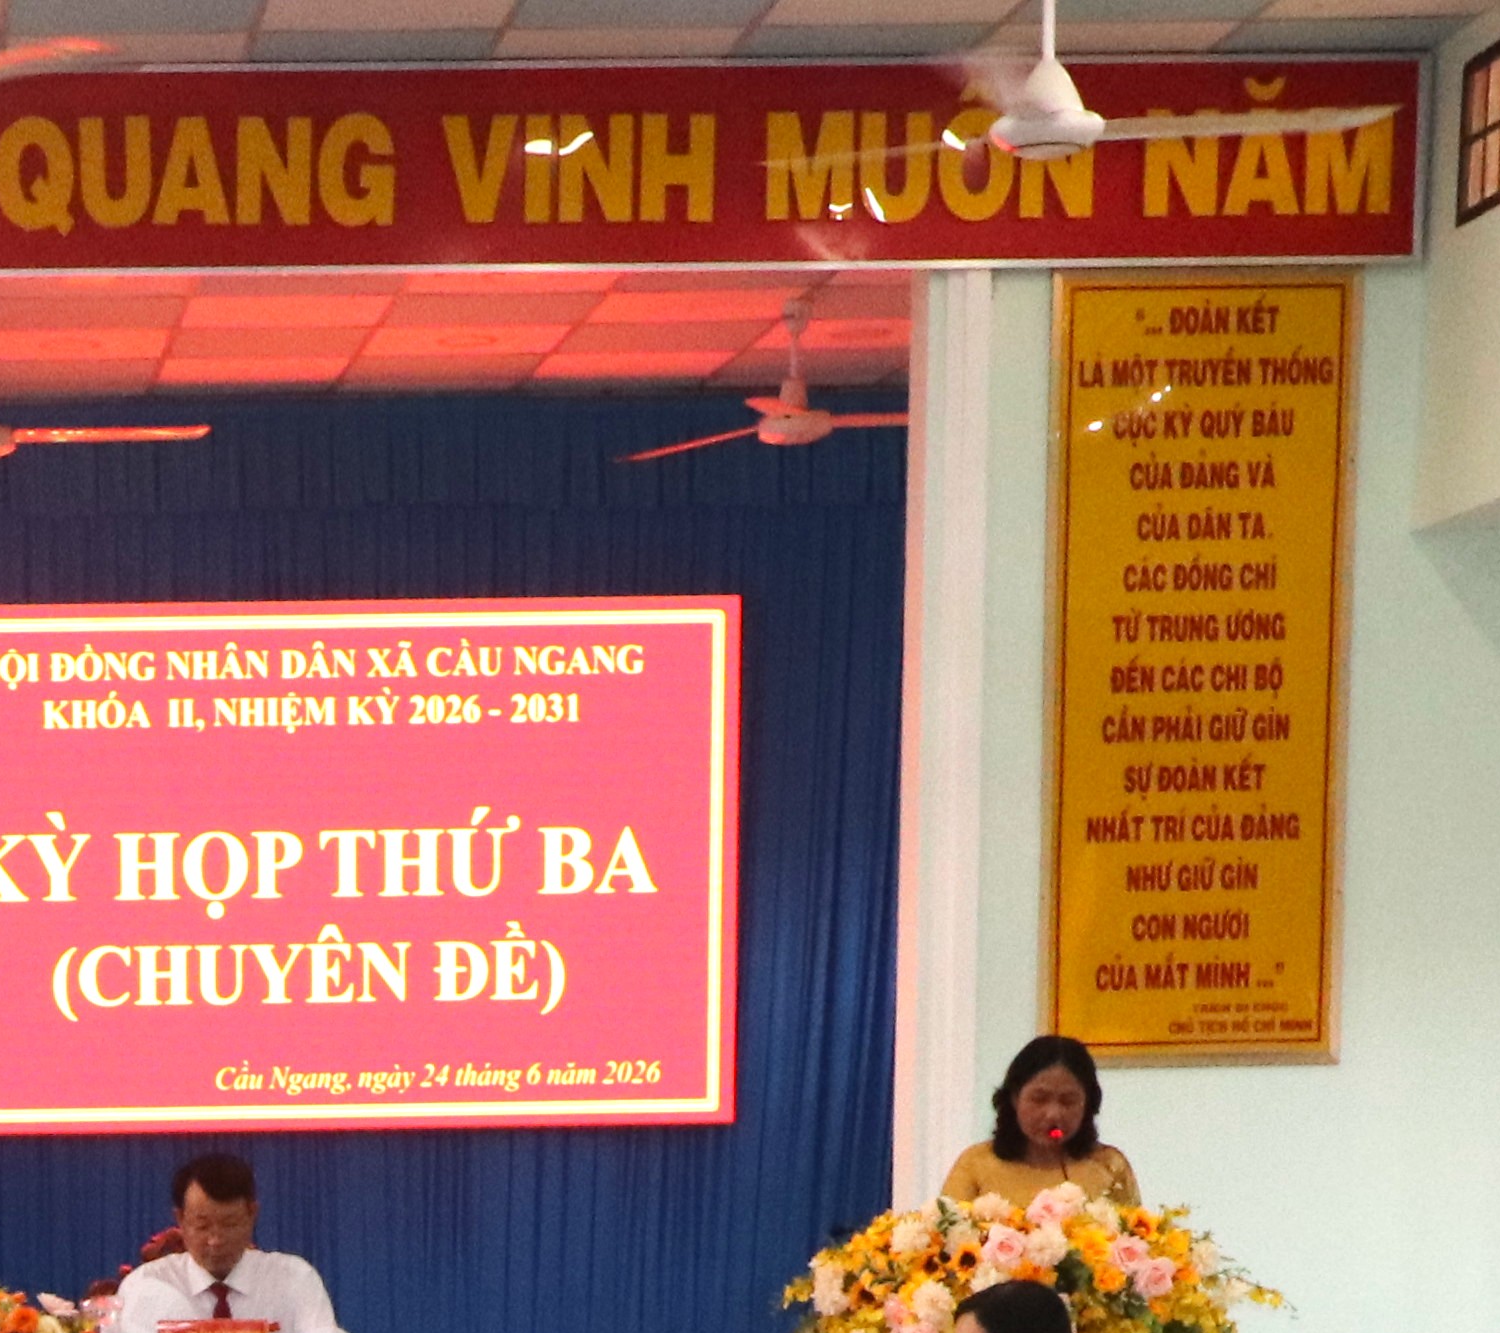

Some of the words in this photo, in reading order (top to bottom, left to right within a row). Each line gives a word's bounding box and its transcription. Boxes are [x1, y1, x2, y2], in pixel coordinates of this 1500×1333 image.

[442, 112, 715, 225] VINH
[767, 82, 1096, 223] MUÔN
[1141, 76, 1394, 217] NĂM
[1169, 298, 1230, 335] ĐOÀN
[1236, 293, 1280, 333] KẾT
[1129, 450, 1173, 490] CỦA
[1178, 448, 1240, 490] ĐẢNG
[1246, 454, 1275, 488] VÀ
[1137, 503, 1181, 540] CỦA
[1187, 506, 1231, 540] DÂN
[1123, 557, 1167, 592] CÁC
[1172, 553, 1234, 590] ĐỒNG
[1240, 555, 1278, 590] CHÍ
[1112, 608, 1141, 642] TỪ
[1147, 614, 1219, 641] TRUNG
[1226, 608, 1286, 641] ƯƠNG
[50, 644, 155, 682] ĐỒNG
[167, 642, 268, 680] NHÂN
[281, 641, 355, 679] DÂN
[367, 641, 417, 677] XÃ
[426, 639, 502, 677] CẦU
[514, 644, 644, 675] NGANG
[1110, 656, 1154, 693] ĐẾN
[1161, 658, 1205, 692] CÁC
[1210, 664, 1247, 692] CHI
[1254, 657, 1284, 700] BỘ
[43, 691, 150, 729] KHÓA
[169, 698, 205, 731] II,
[214, 692, 336, 733] NHIỆM
[348, 687, 399, 725] KỲ
[409, 694, 481, 724] 2026
[510, 693, 579, 723] 2031
[1123, 762, 1153, 801] SỰ
[1157, 758, 1217, 792] ĐOÀN
[1223, 753, 1266, 792] KẾT
[1086, 809, 1144, 843] NHẤT
[1151, 808, 1185, 842] TRÍ
[1191, 804, 1234, 841] CỦA
[1240, 804, 1300, 841] ĐẢNG
[114, 831, 303, 919] HỌP
[319, 806, 520, 897] THỨ
[538, 826, 657, 894] BA
[1126, 859, 1172, 892] NHƯ
[1177, 856, 1215, 891] GIỮ
[1220, 856, 1258, 890] GÌN
[53, 924, 411, 1021] (CHUYÊN
[433, 921, 565, 1014] ĐỀ)
[216, 1061, 263, 1090] Cầu
[269, 1067, 351, 1095] Ngang,
[358, 1064, 415, 1094] ngày
[420, 1064, 449, 1087] 24
[455, 1063, 522, 1092] tháng
[527, 1063, 541, 1084] 6
[547, 1063, 596, 1085] năm
[602, 1060, 660, 1084] 2026
